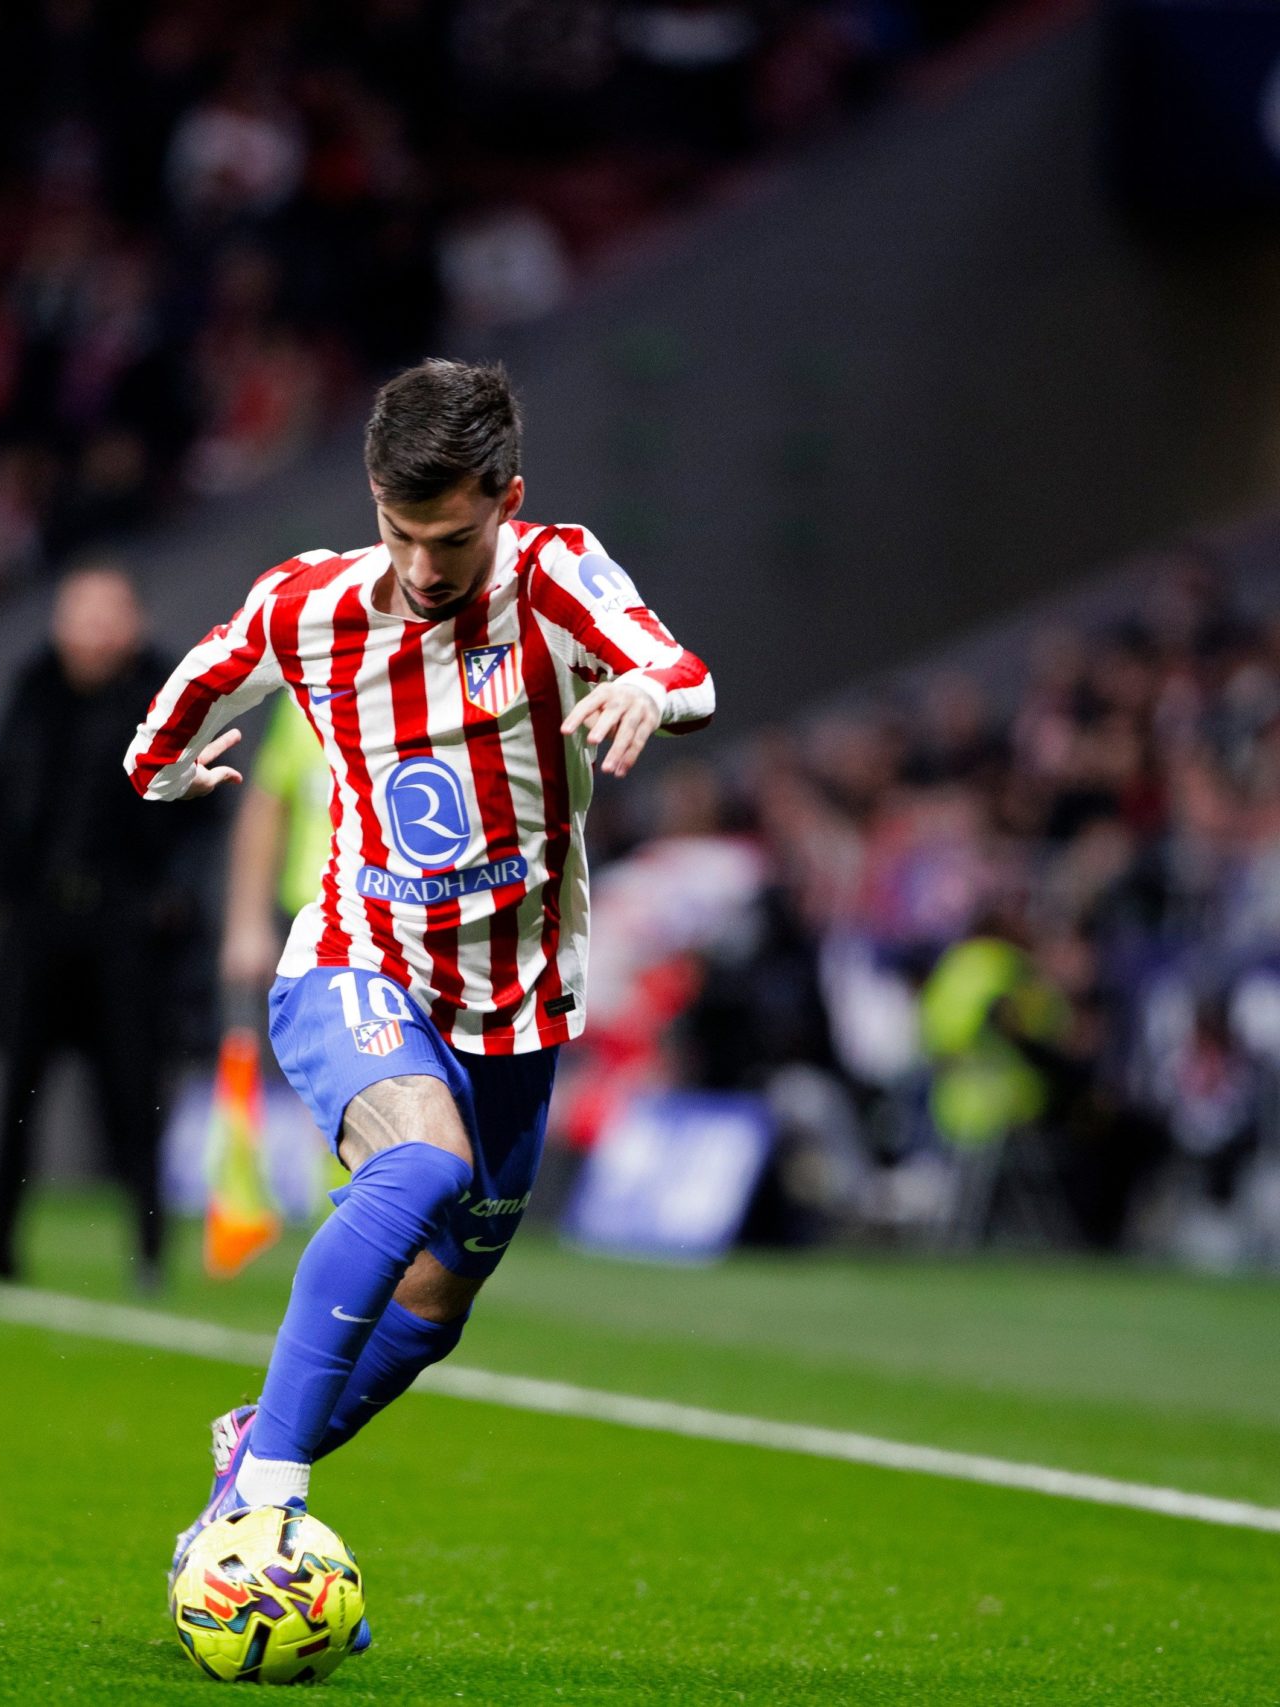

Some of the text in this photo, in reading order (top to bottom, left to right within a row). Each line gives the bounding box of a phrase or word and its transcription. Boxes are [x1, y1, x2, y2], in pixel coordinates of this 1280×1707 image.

[363, 860, 522, 902] RIYADH AIR
[327, 971, 415, 1029] 10
